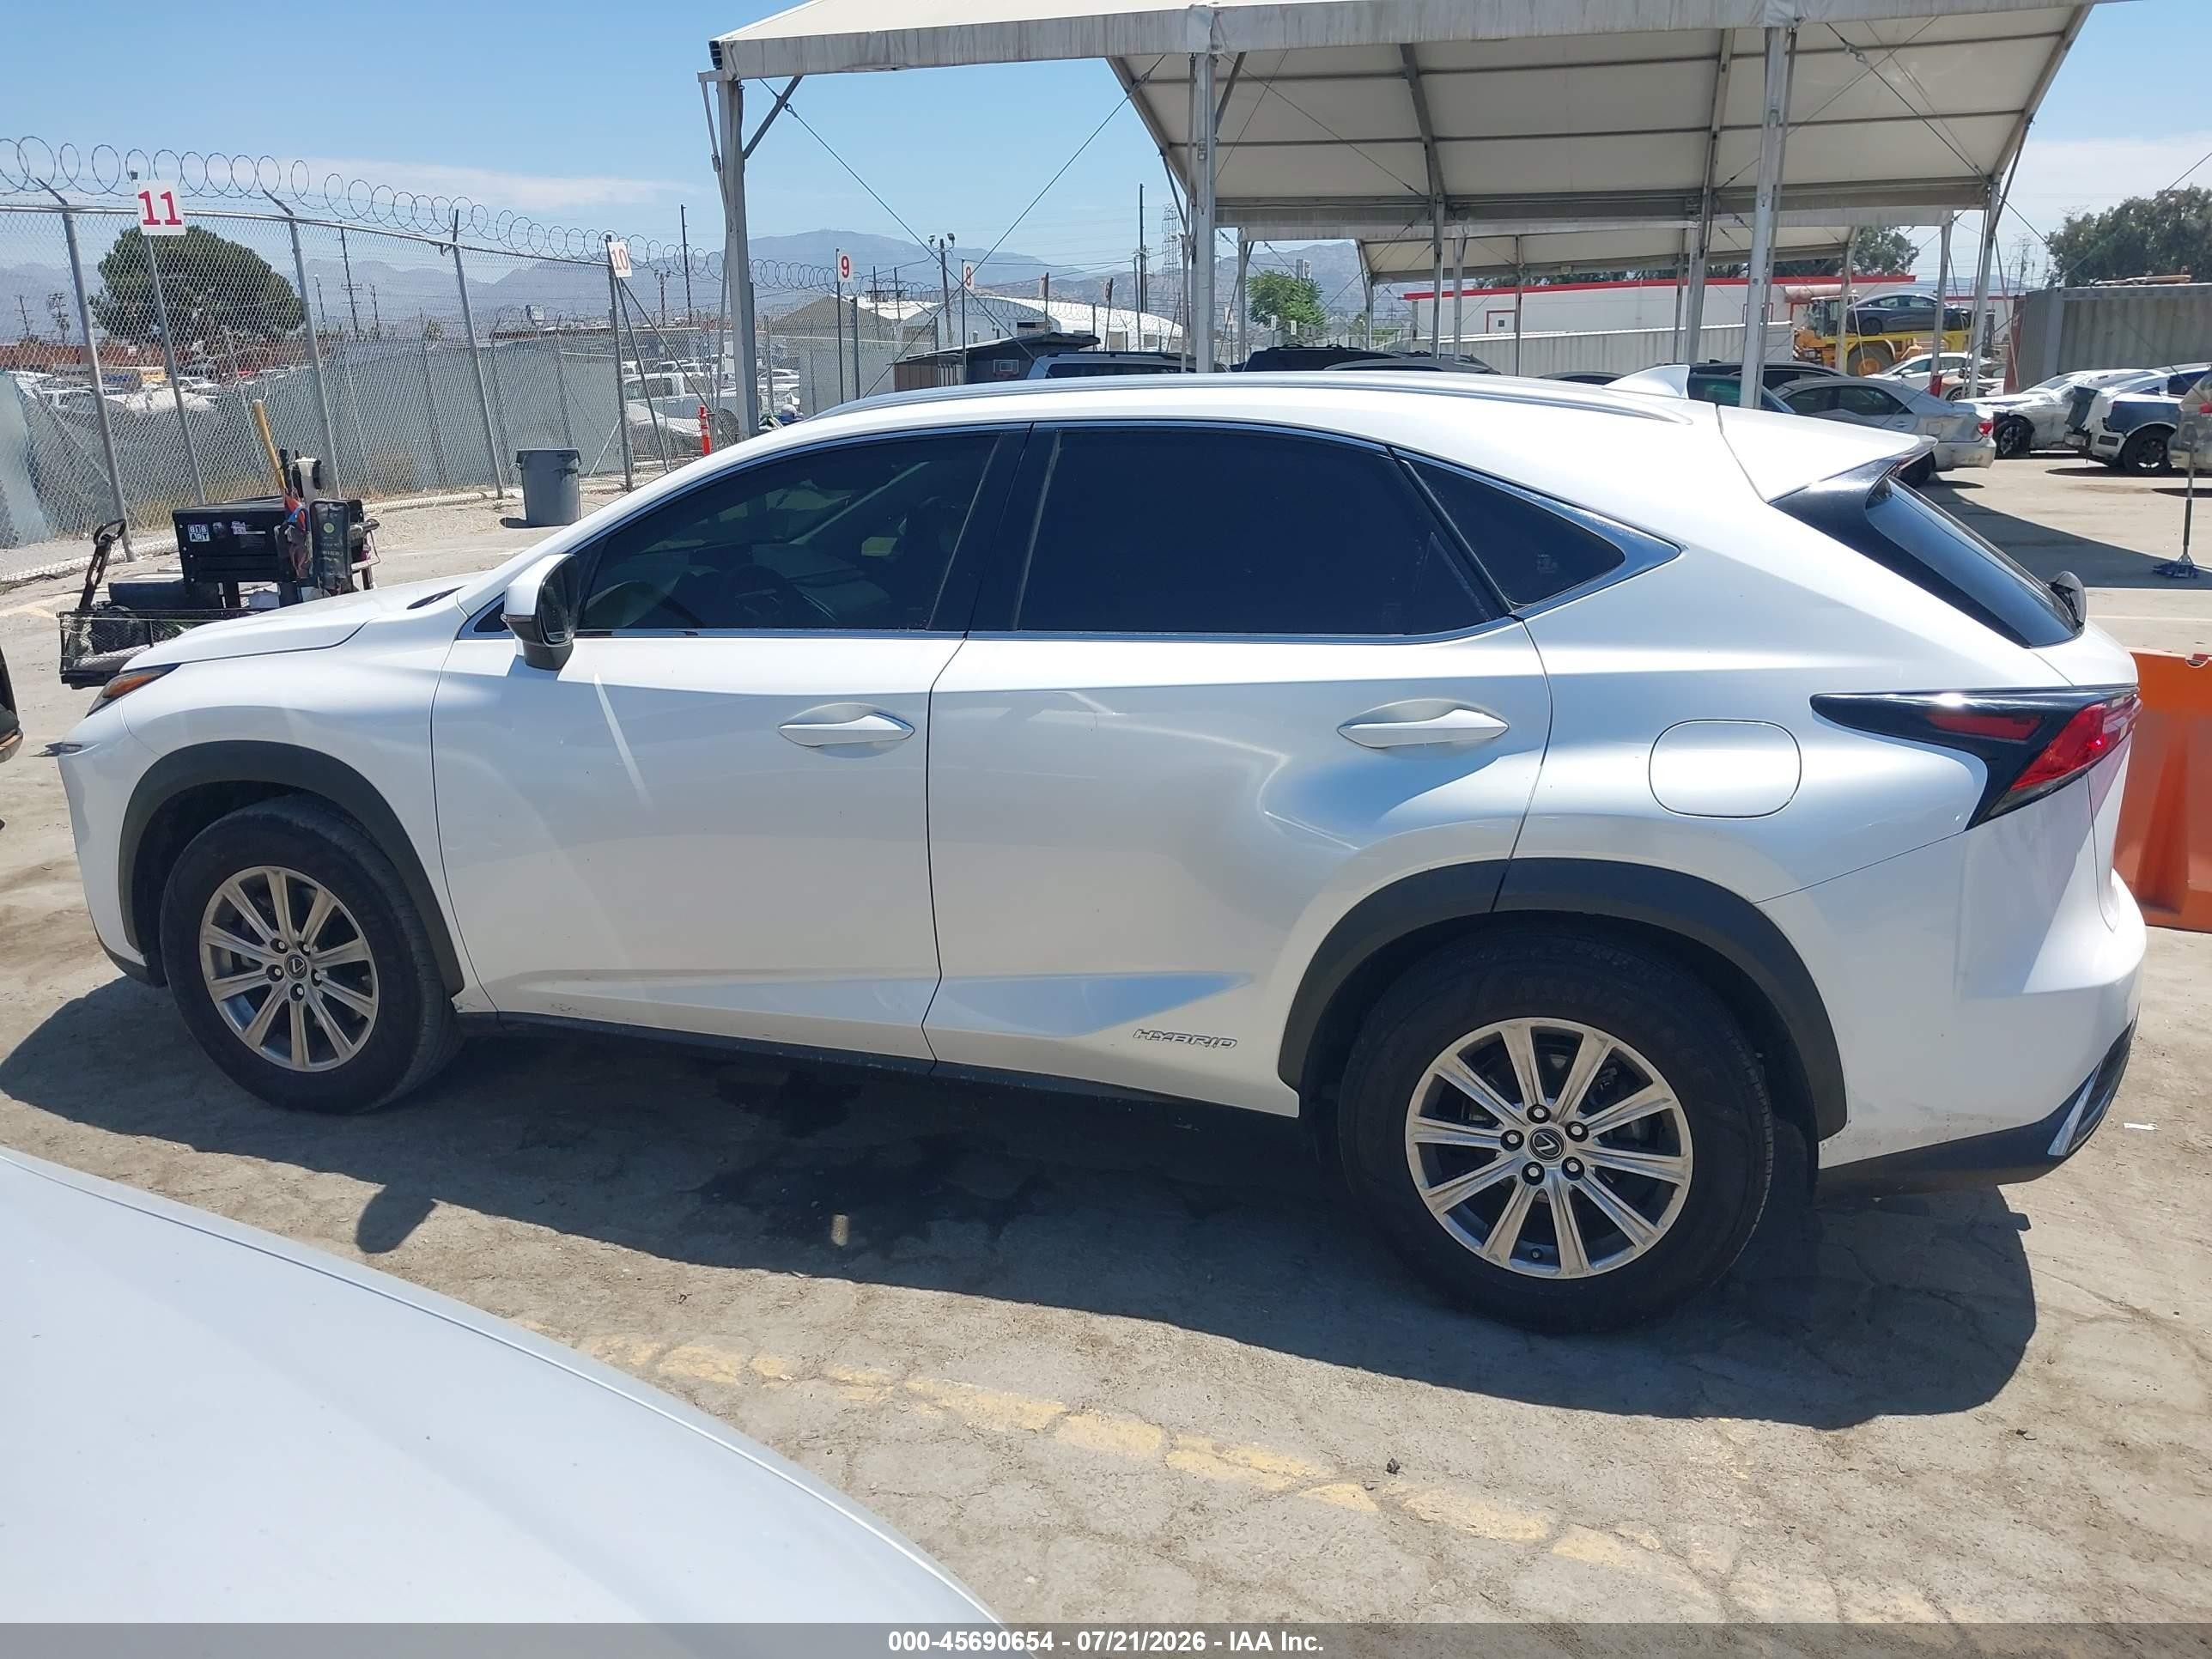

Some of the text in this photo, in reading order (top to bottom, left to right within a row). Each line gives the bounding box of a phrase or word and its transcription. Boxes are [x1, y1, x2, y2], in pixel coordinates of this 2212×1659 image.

[137, 190, 182, 226] 11
[611, 248, 629, 270] 10
[841, 255, 850, 279] 9
[965, 266, 972, 287] 8
[1133, 1029, 1238, 1048] HYBRID
